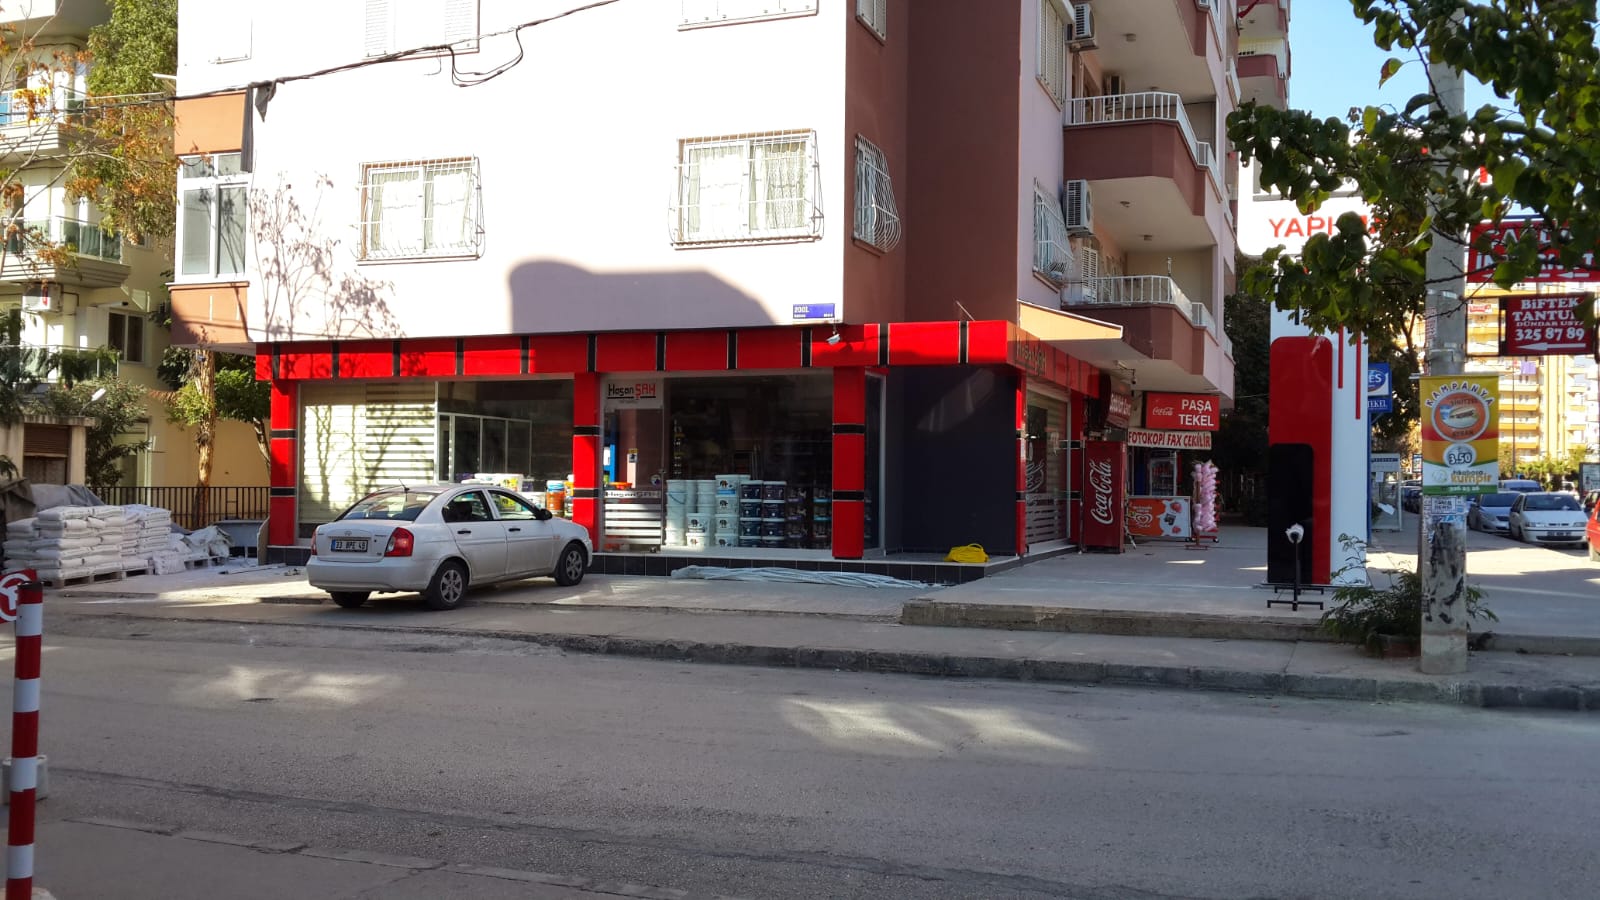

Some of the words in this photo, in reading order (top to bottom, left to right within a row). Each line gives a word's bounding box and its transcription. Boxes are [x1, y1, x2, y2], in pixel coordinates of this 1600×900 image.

[1515, 329, 1542, 341] 325
[1545, 328, 1564, 341] 87
[1566, 327, 1585, 341] 89
[608, 383, 634, 397] Hasan
[1425, 381, 1496, 407] KAMPANYA
[1181, 399, 1212, 414] PAŞA
[1178, 414, 1215, 427] TEKEL
[1167, 434, 1182, 447] FAX
[1449, 453, 1473, 464] 3.50
